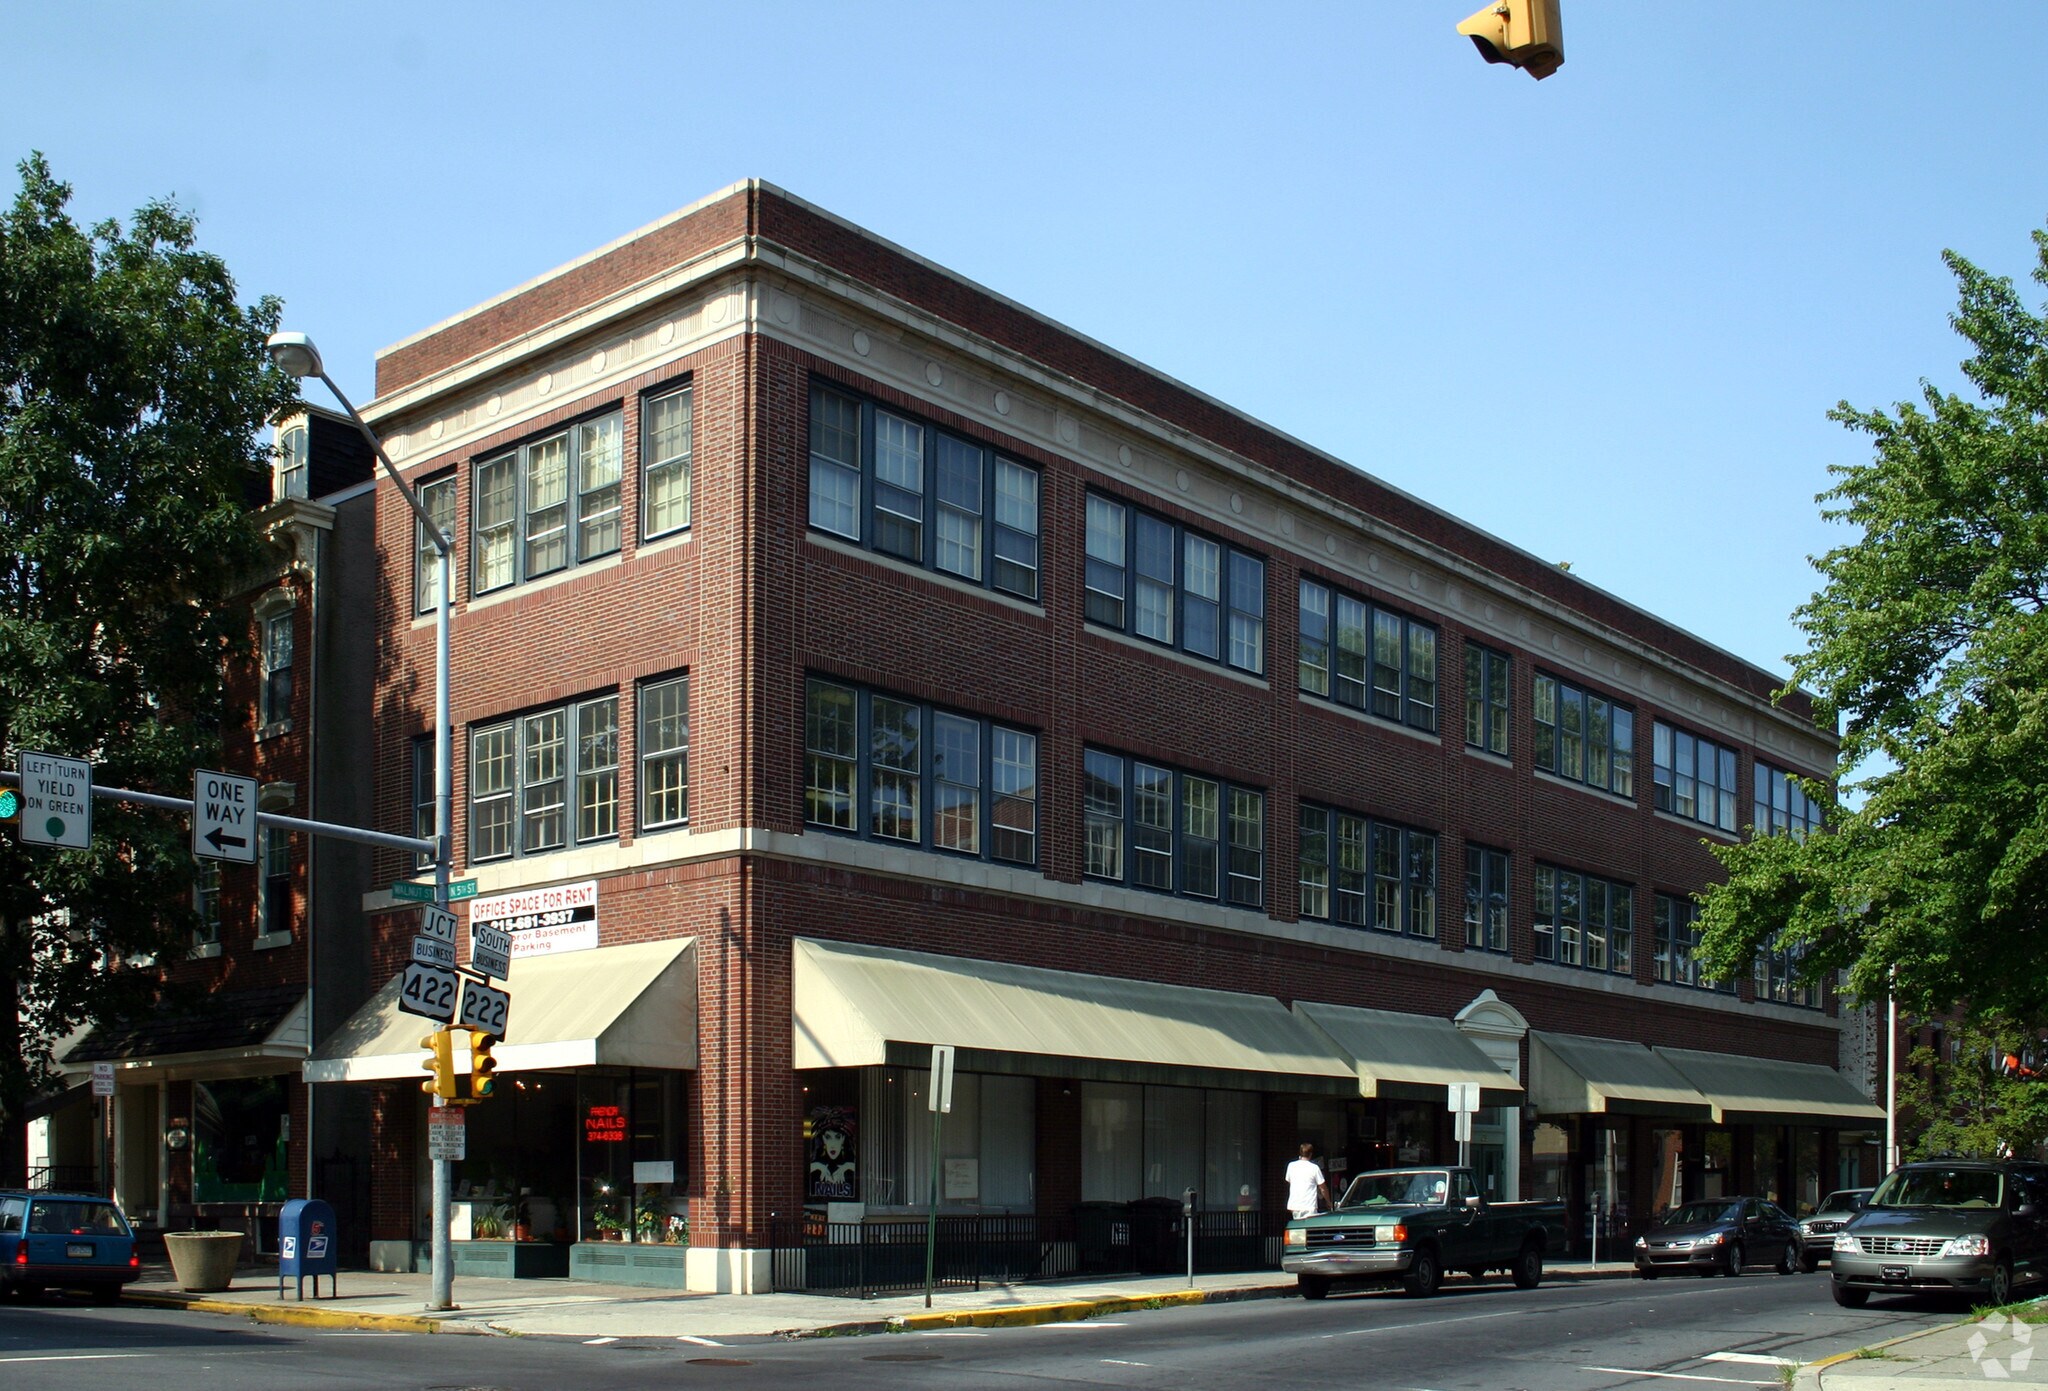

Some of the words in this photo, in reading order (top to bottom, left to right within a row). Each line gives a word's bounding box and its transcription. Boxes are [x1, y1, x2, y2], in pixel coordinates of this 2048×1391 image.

[26, 760, 53, 774] LEFT
[57, 765, 86, 780] TURN
[38, 779, 75, 797] YIELD
[207, 780, 244, 803] ONE
[28, 797, 43, 809] ON
[48, 799, 84, 815] GREEN
[206, 802, 245, 825] WAY
[394, 886, 423, 898] WALNUT
[425, 888, 434, 899] ST
[467, 883, 476, 894] ST
[474, 901, 506, 919] OFFICE
[509, 895, 540, 914] SPACE
[543, 892, 563, 909] FOR
[565, 887, 593, 906] RENT
[424, 912, 457, 940] JCT
[490, 909, 575, 932] 215-681-3937
[478, 928, 511, 955] SOUTH
[522, 932, 532, 941] or
[535, 924, 587, 939] Basement
[416, 943, 454, 964] BUSINESS
[513, 942, 552, 953] Parking
[475, 953, 507, 975] BUSINESS
[405, 974, 454, 1010] 422
[464, 991, 506, 1028] 222
[586, 1117, 625, 1130] NAILS
[814, 1182, 851, 1197] NAILS
